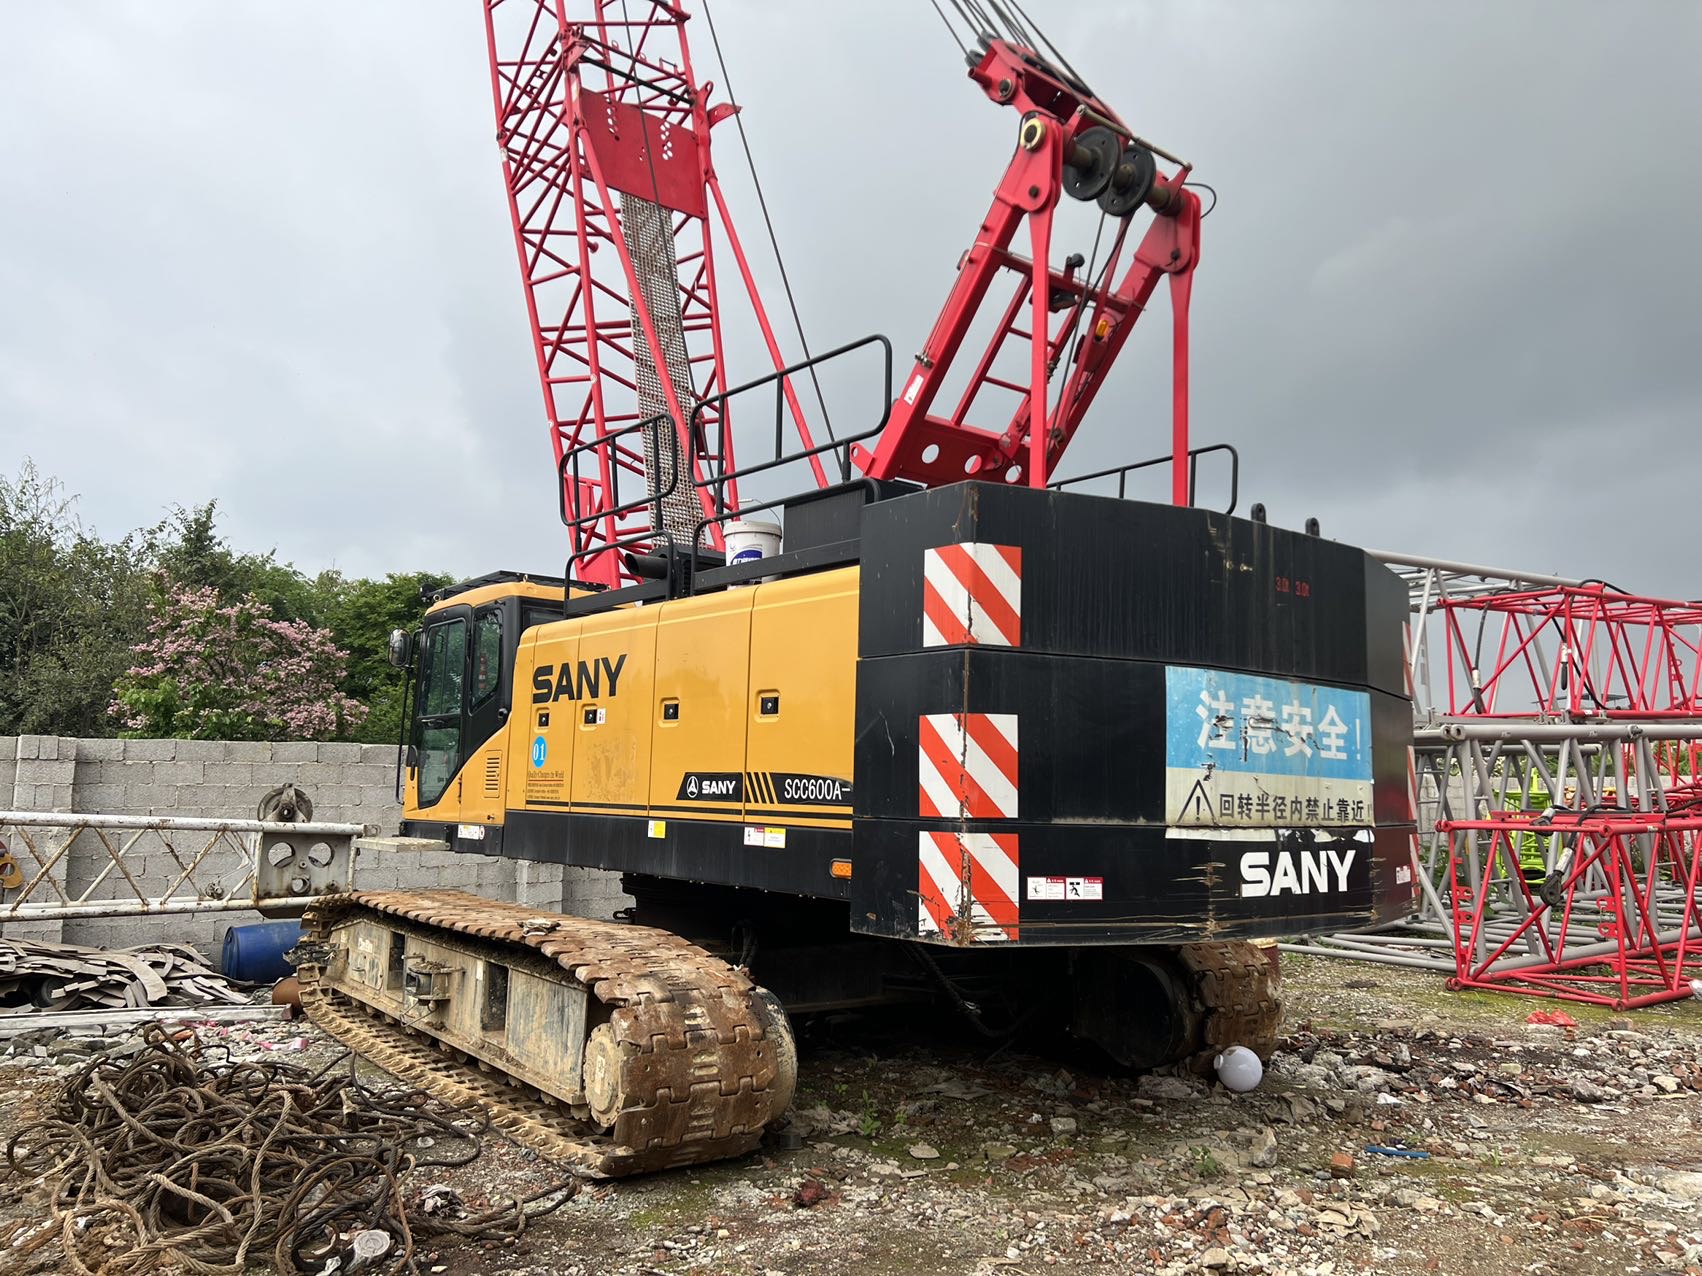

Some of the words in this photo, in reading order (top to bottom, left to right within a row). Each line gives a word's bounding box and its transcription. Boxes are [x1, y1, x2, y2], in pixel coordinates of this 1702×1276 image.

[533, 654, 627, 704] SANY
[533, 743, 544, 761] 01
[702, 780, 736, 794] SANY
[1240, 850, 1356, 898] SANY
